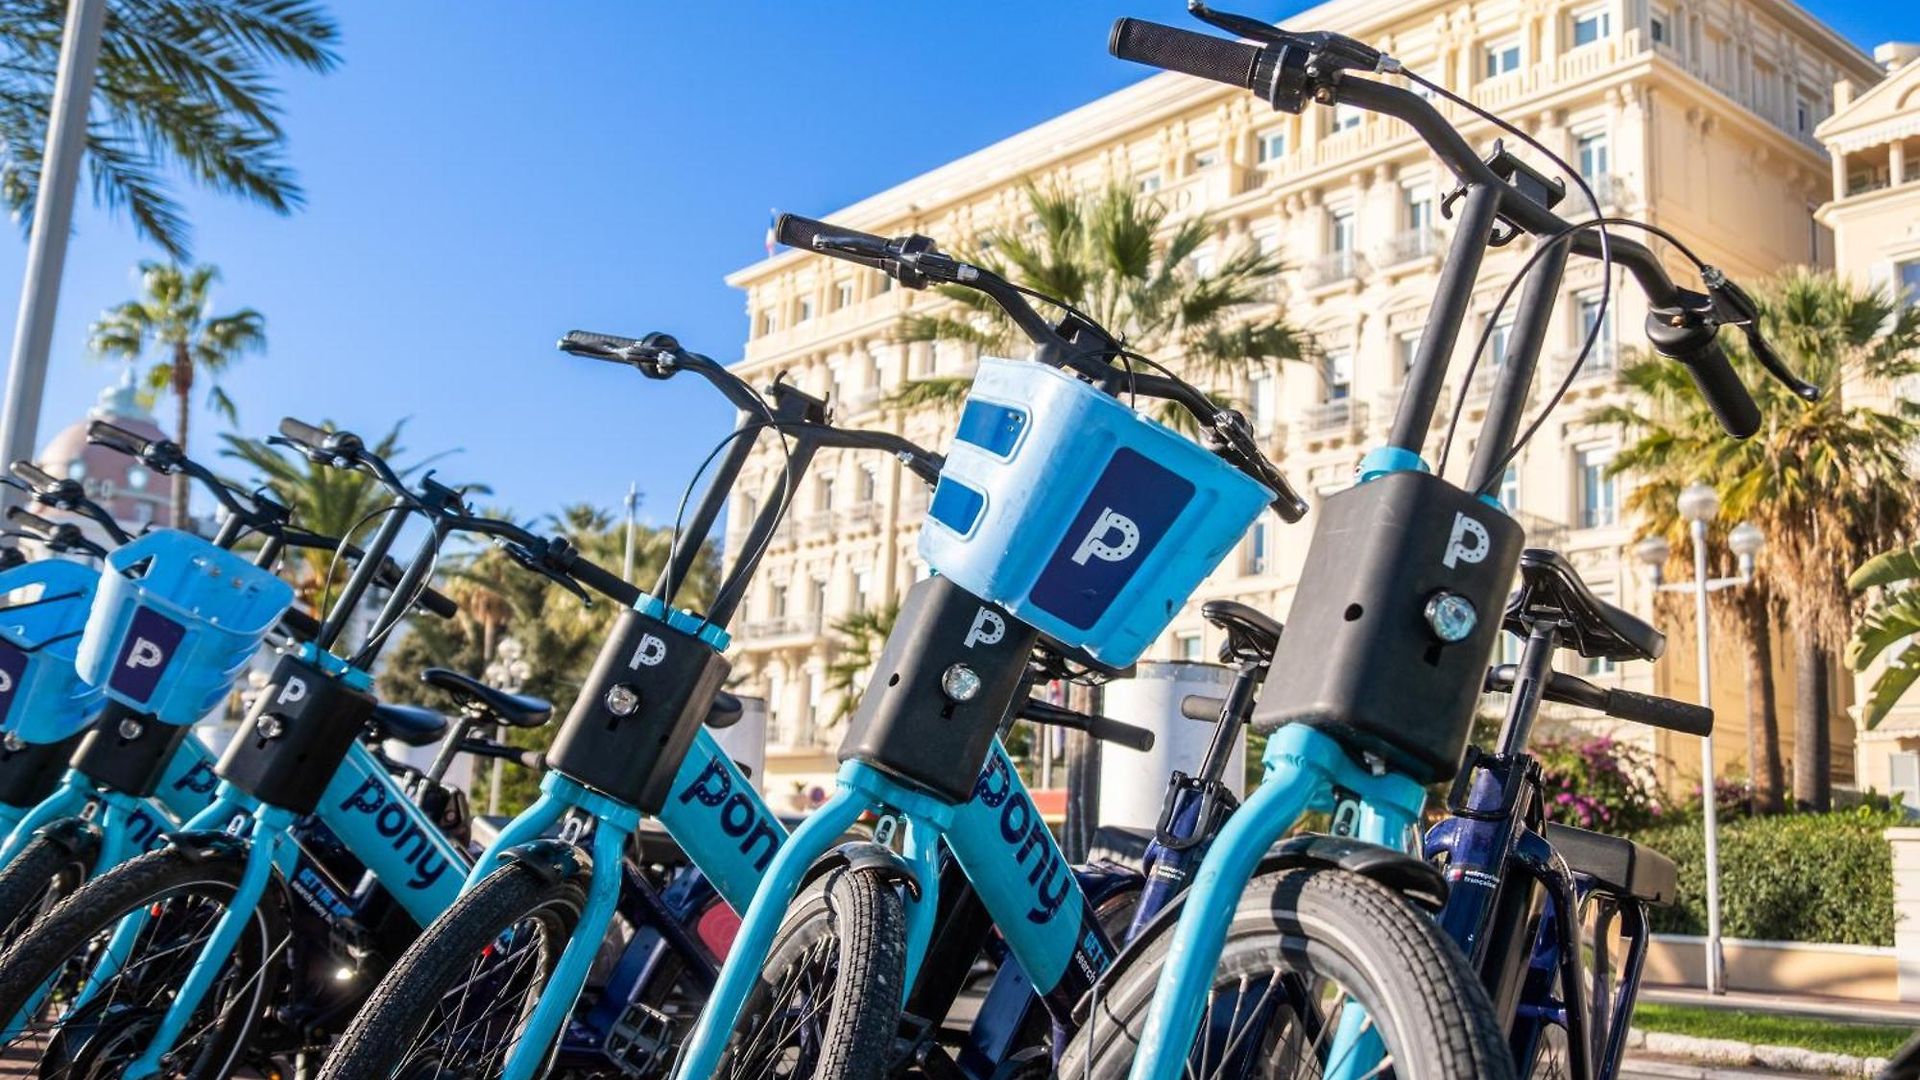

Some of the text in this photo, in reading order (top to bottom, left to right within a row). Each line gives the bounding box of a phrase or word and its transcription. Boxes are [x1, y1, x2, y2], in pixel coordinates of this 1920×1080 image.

[1442, 510, 1490, 569] P
[678, 754, 779, 873] pon
[1075, 950, 1096, 984] search
